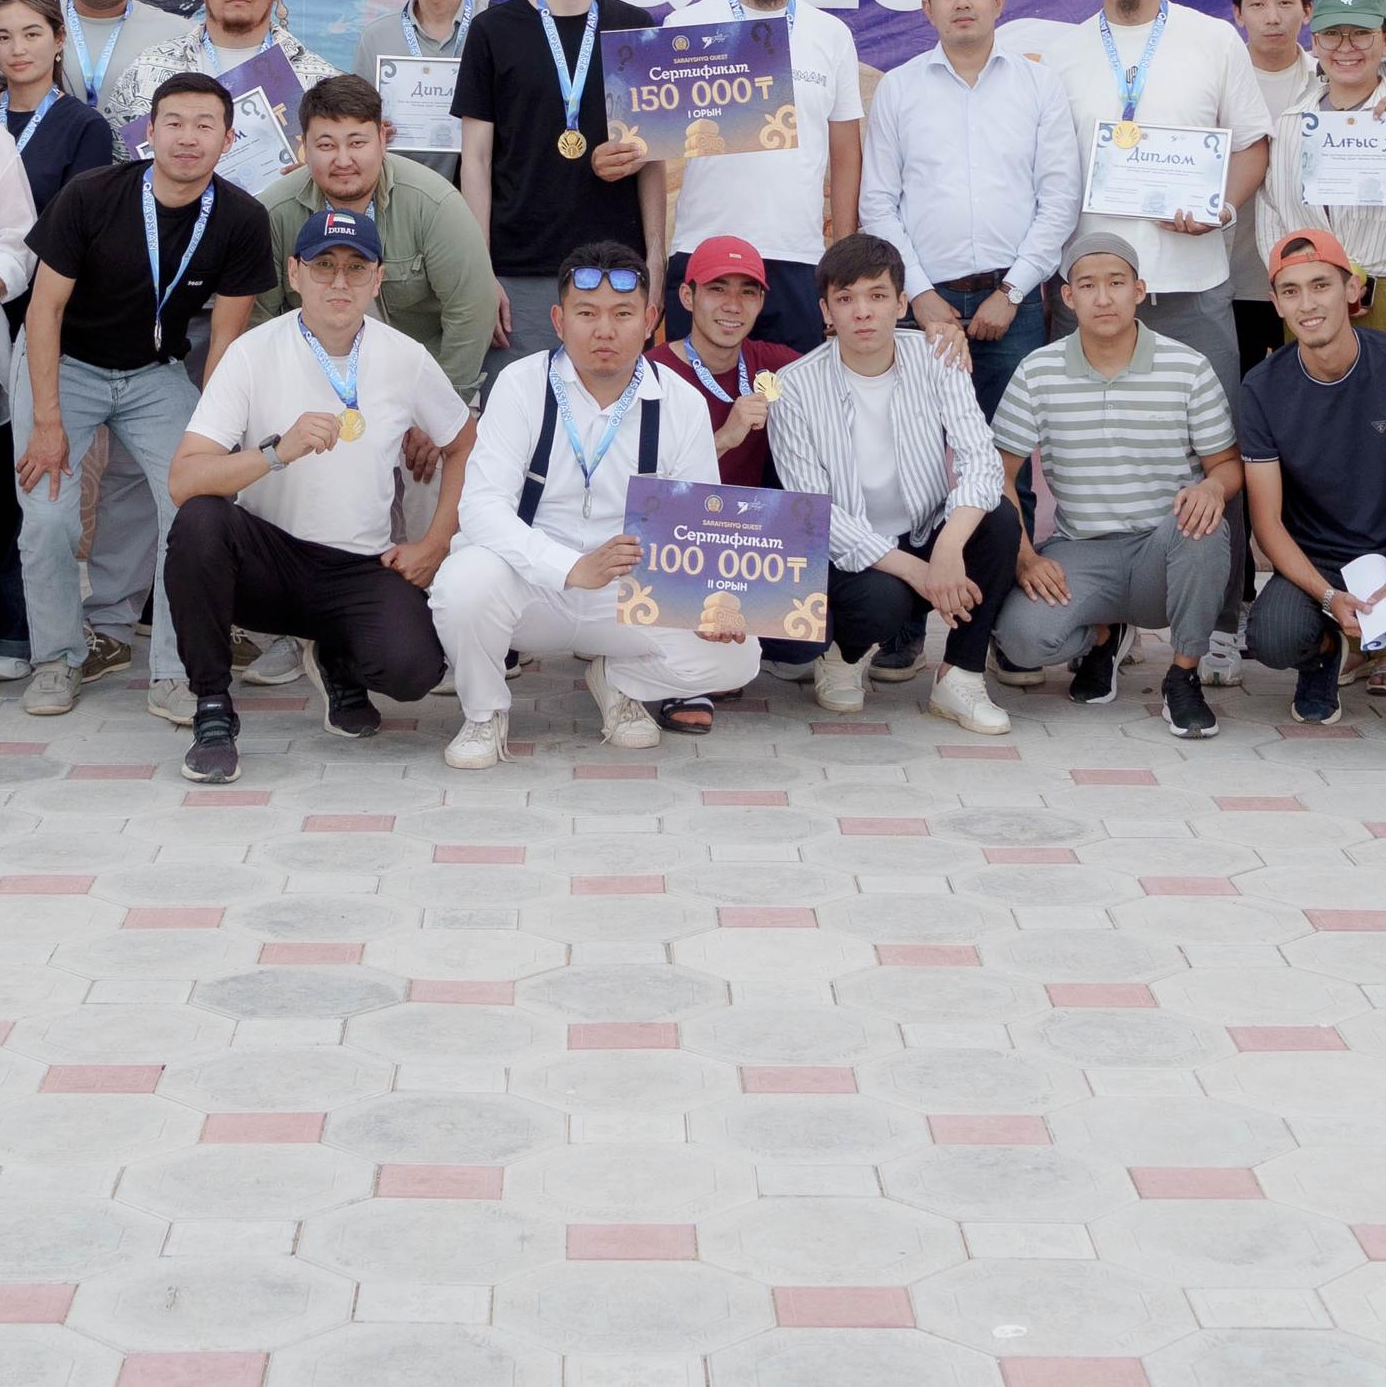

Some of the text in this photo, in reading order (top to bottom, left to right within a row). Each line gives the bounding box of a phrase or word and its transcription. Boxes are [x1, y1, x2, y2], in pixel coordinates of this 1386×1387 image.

[541, 8, 566, 70] QAZAQSTAN
[577, 12, 598, 75] QAZAQSTAN
[649, 63, 750, 82] Сертификат
[630, 83, 680, 112] 150
[693, 108, 722, 118] ОРЫН
[1321, 132, 1379, 148] Алғыс
[1126, 147, 1196, 166] Диплом
[143, 182, 158, 250] QAZAQSTAN
[328, 226, 357, 236] DUBAI
[673, 525, 784, 549] Сертификат
[647, 543, 704, 575] 100
[716, 580, 748, 592] ОРЫН
